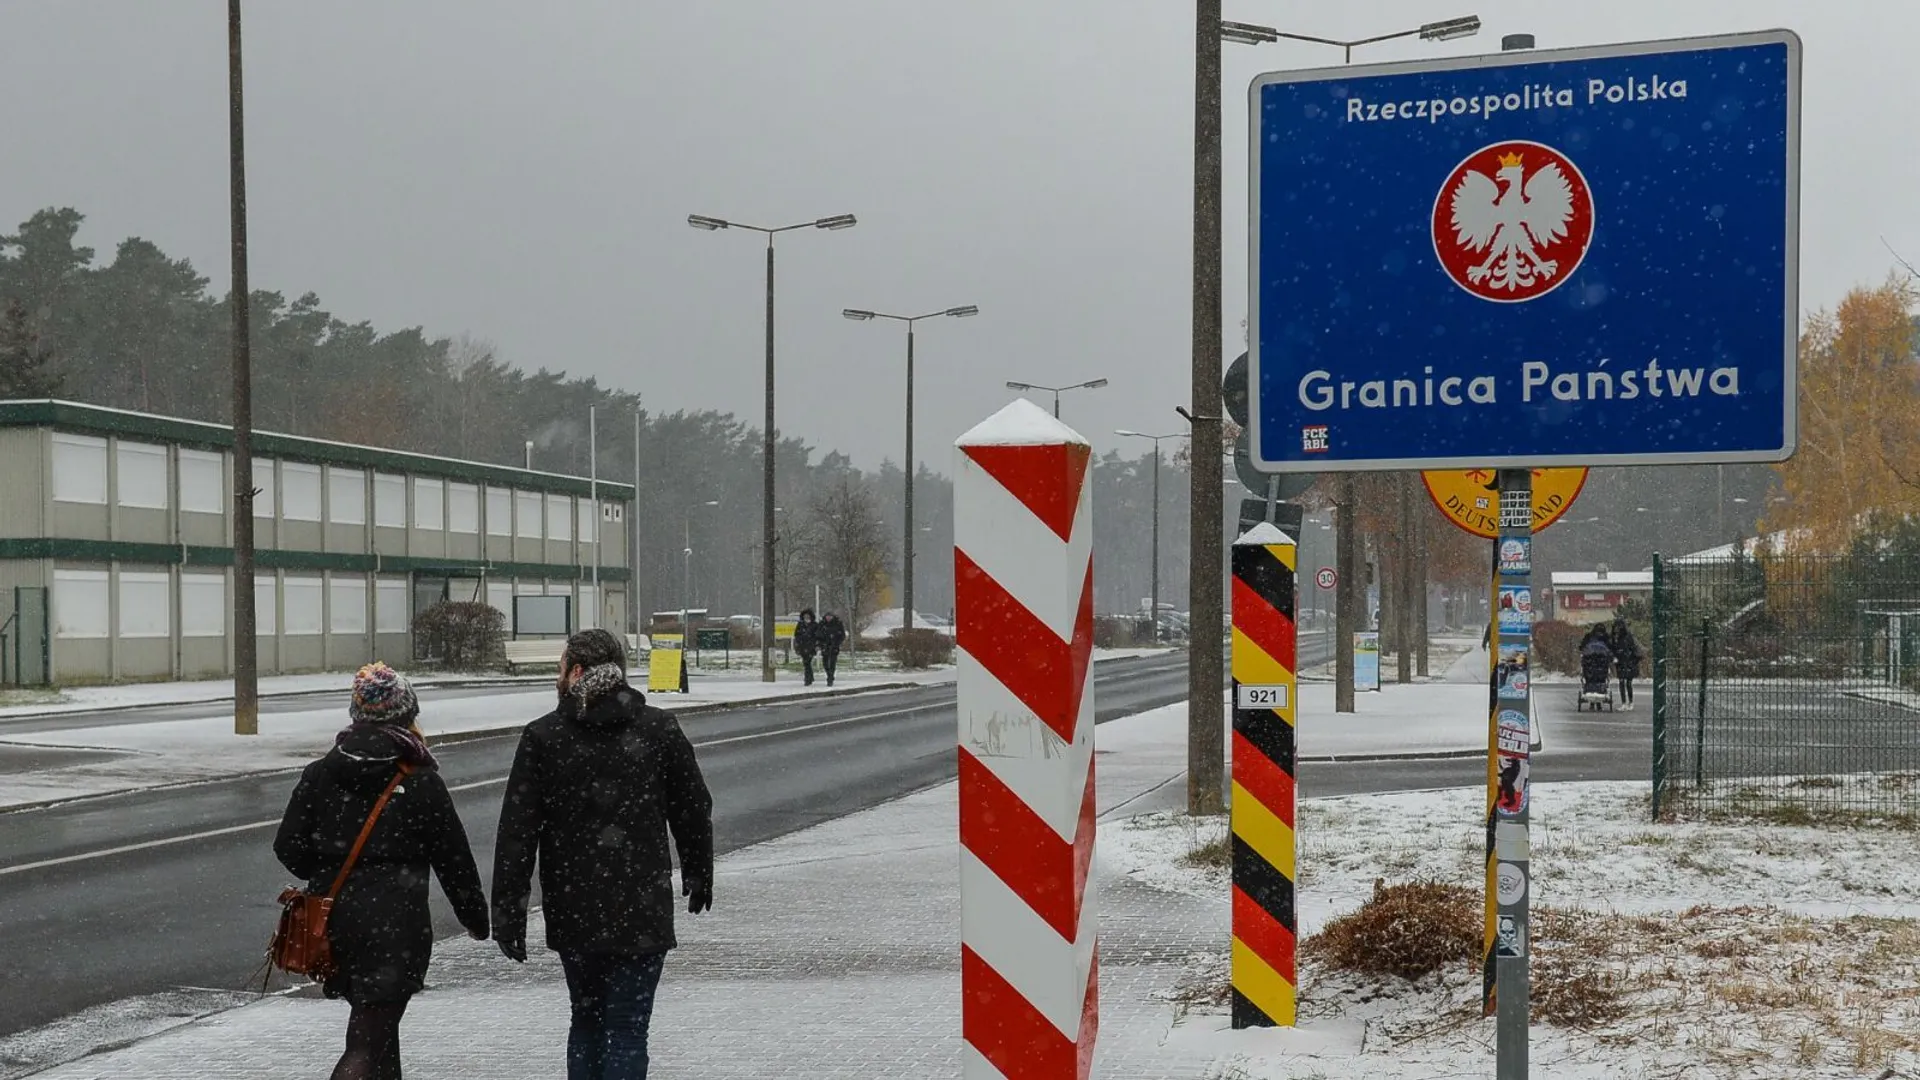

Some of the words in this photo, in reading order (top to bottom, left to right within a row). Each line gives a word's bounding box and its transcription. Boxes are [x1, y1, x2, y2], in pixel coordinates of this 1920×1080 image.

[1347, 85, 1573, 124] Rzeczpospolita
[1588, 74, 1687, 104] Polska
[1299, 365, 1496, 410] Granica
[1523, 357, 1739, 402] Państwa
[1302, 427, 1328, 439] FCK
[1303, 438, 1329, 450] RBL
[1320, 573, 1333, 584] 30
[1250, 690, 1277, 703] 921
